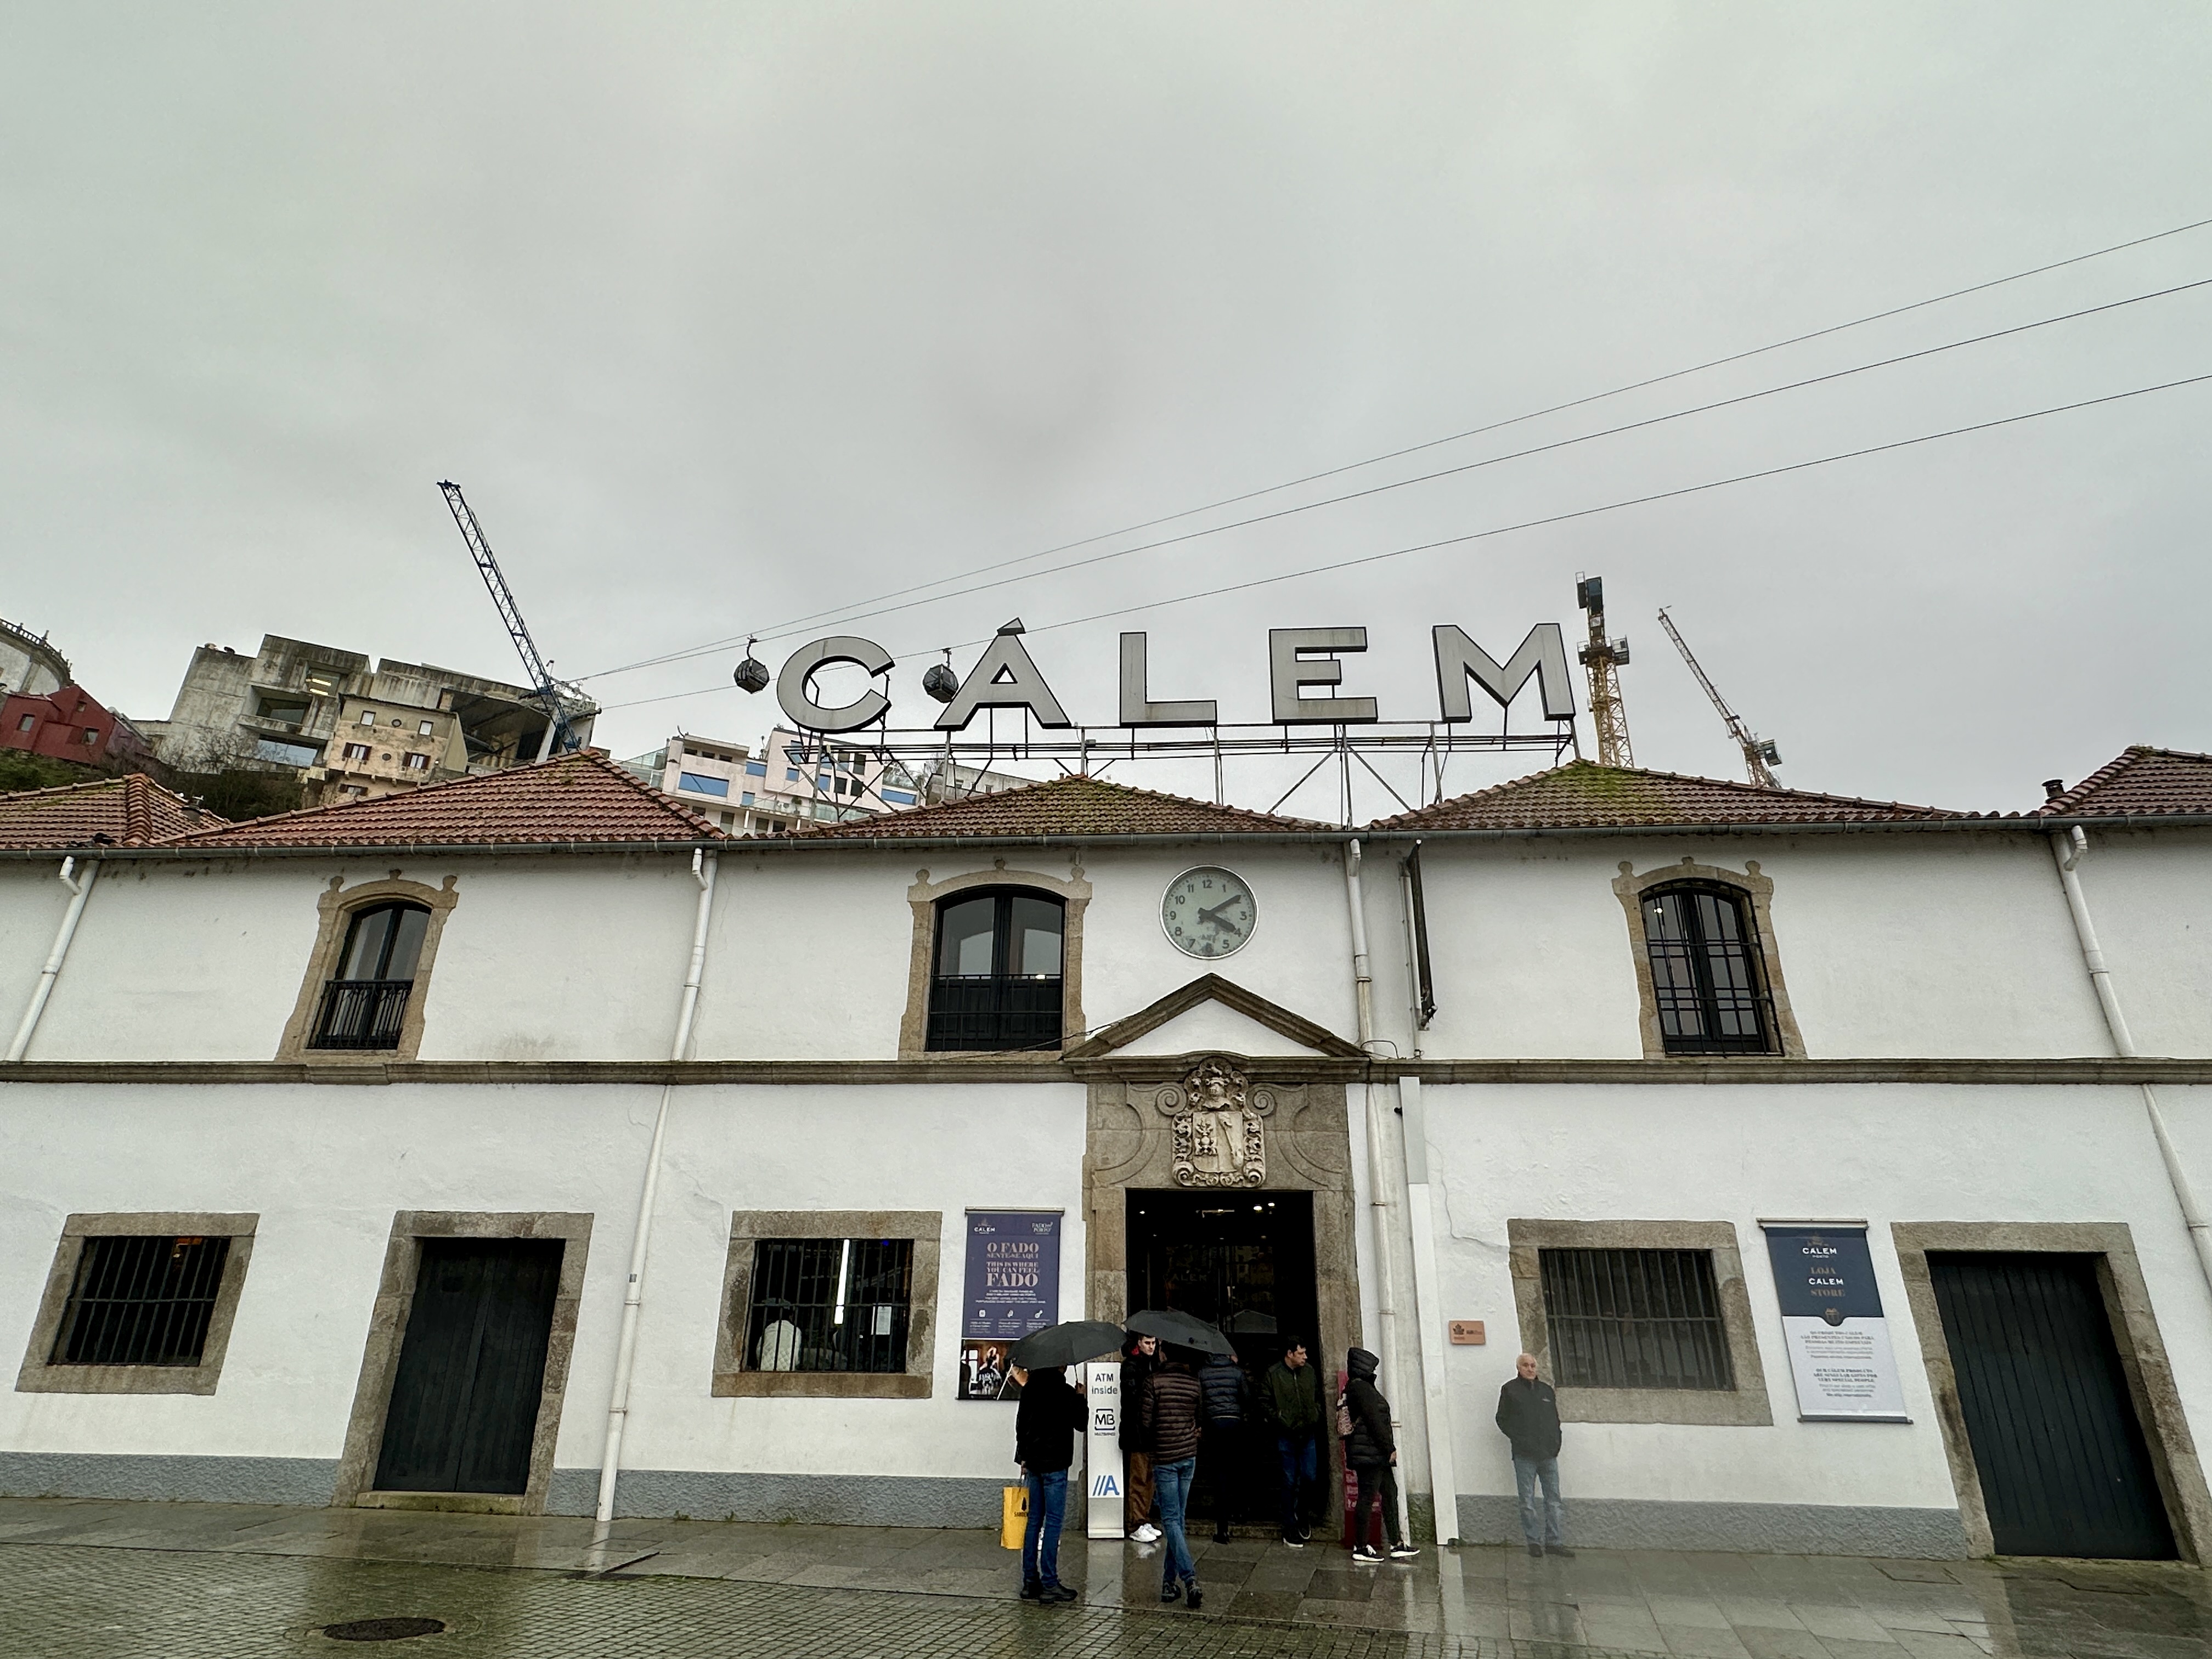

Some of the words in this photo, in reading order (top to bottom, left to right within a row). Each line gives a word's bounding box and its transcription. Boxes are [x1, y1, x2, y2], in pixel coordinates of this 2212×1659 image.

[1203, 879, 1212, 888] 12
[1187, 884, 1194, 893] 11
[1175, 895, 1185, 904] 10
[1170, 911, 1176, 919] 9
[1239, 911, 1247, 920] 3
[1175, 927, 1182, 935] 8
[1234, 928, 1242, 937] 4
[1189, 939, 1195, 948] 7
[1222, 940, 1229, 949] 5
[987, 1243, 997, 1252] O
[1001, 1243, 1039, 1252] FADO
[986, 1273, 1038, 1286] FADO
[1096, 1373, 1113, 1382] ATM
[1092, 1386, 1118, 1394] inside
[1095, 1414, 1115, 1425] MB
